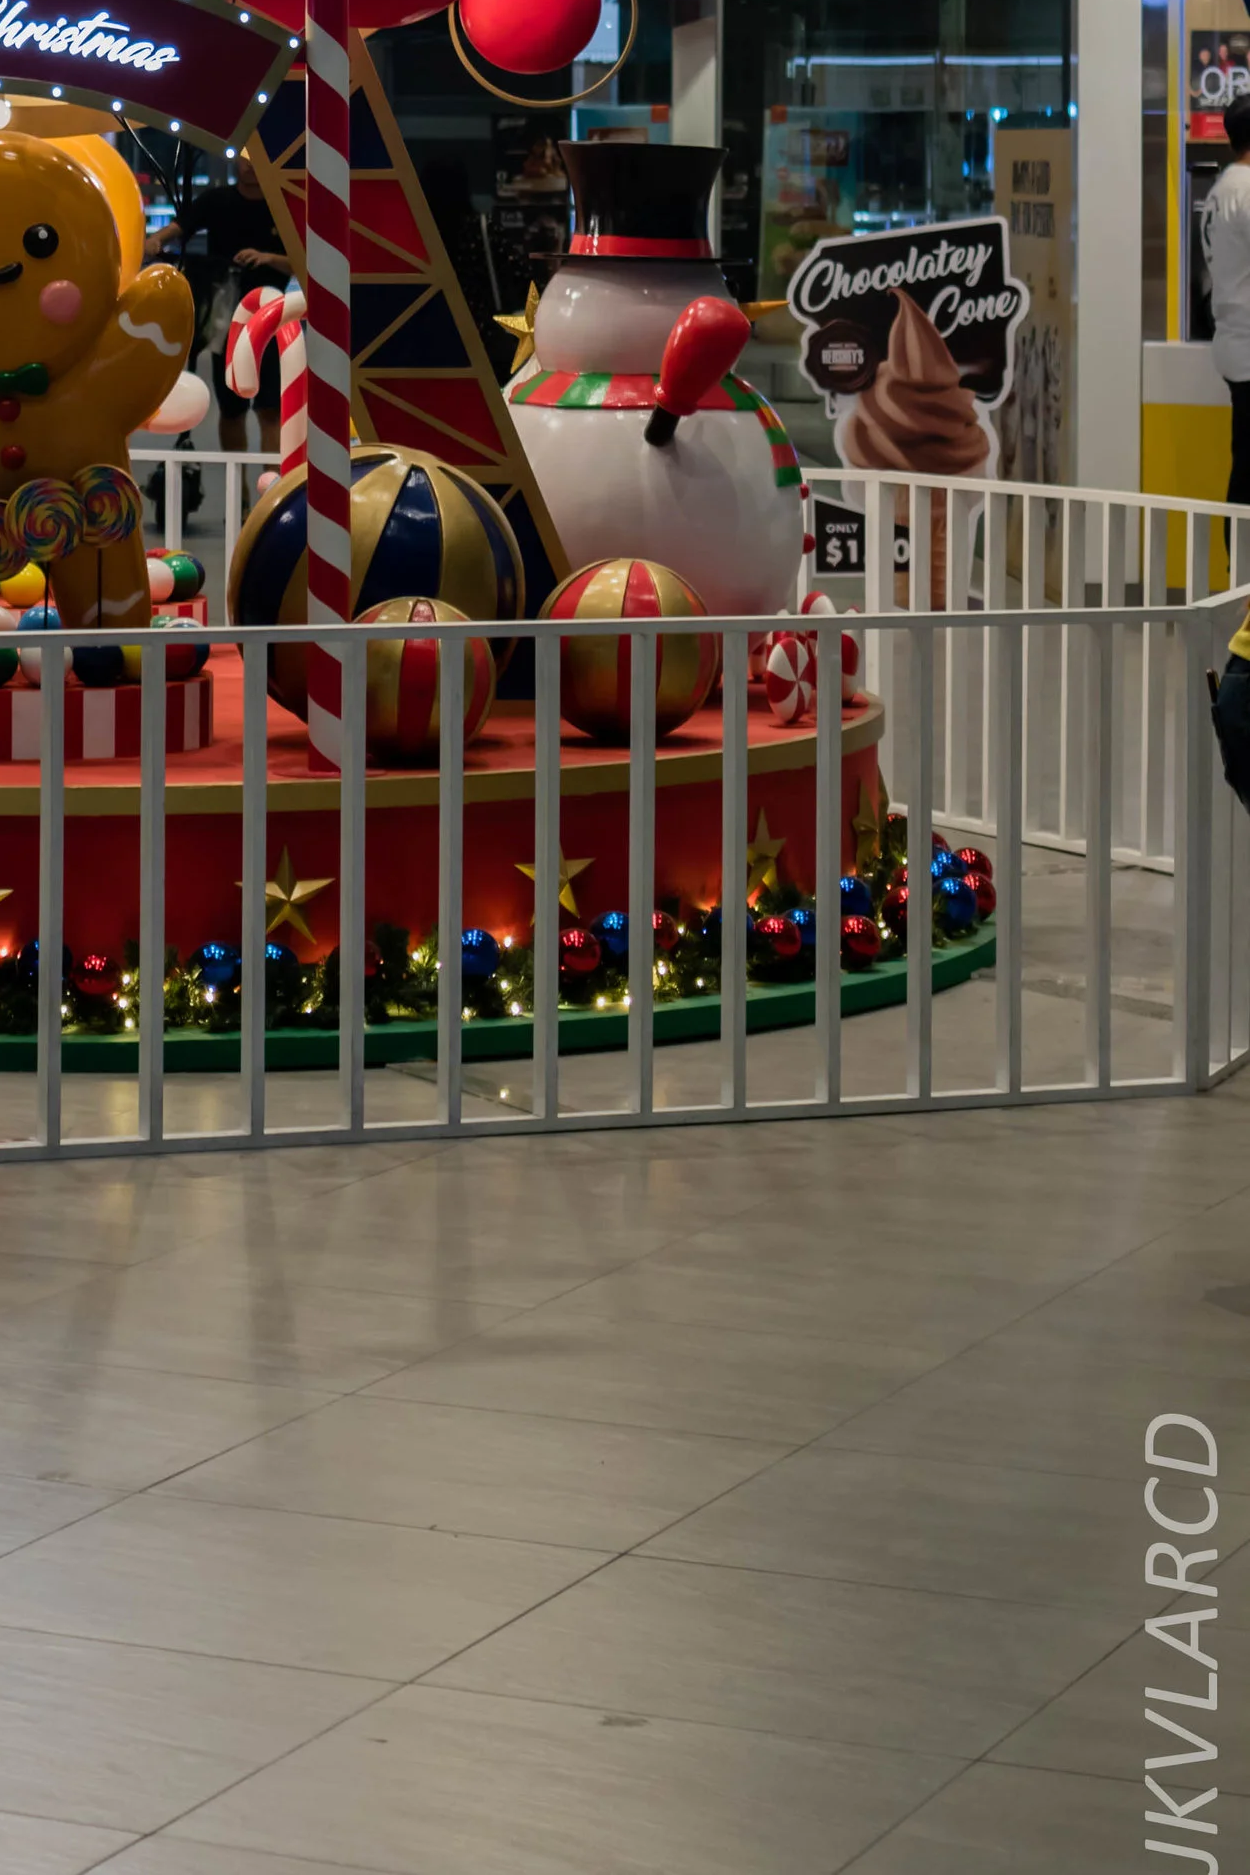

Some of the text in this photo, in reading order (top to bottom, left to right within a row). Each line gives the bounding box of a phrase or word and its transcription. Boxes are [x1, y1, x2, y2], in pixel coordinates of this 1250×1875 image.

[800, 239, 993, 313] Chocolatey
[927, 285, 1018, 339] Cone
[825, 522, 859, 534] ONLY
